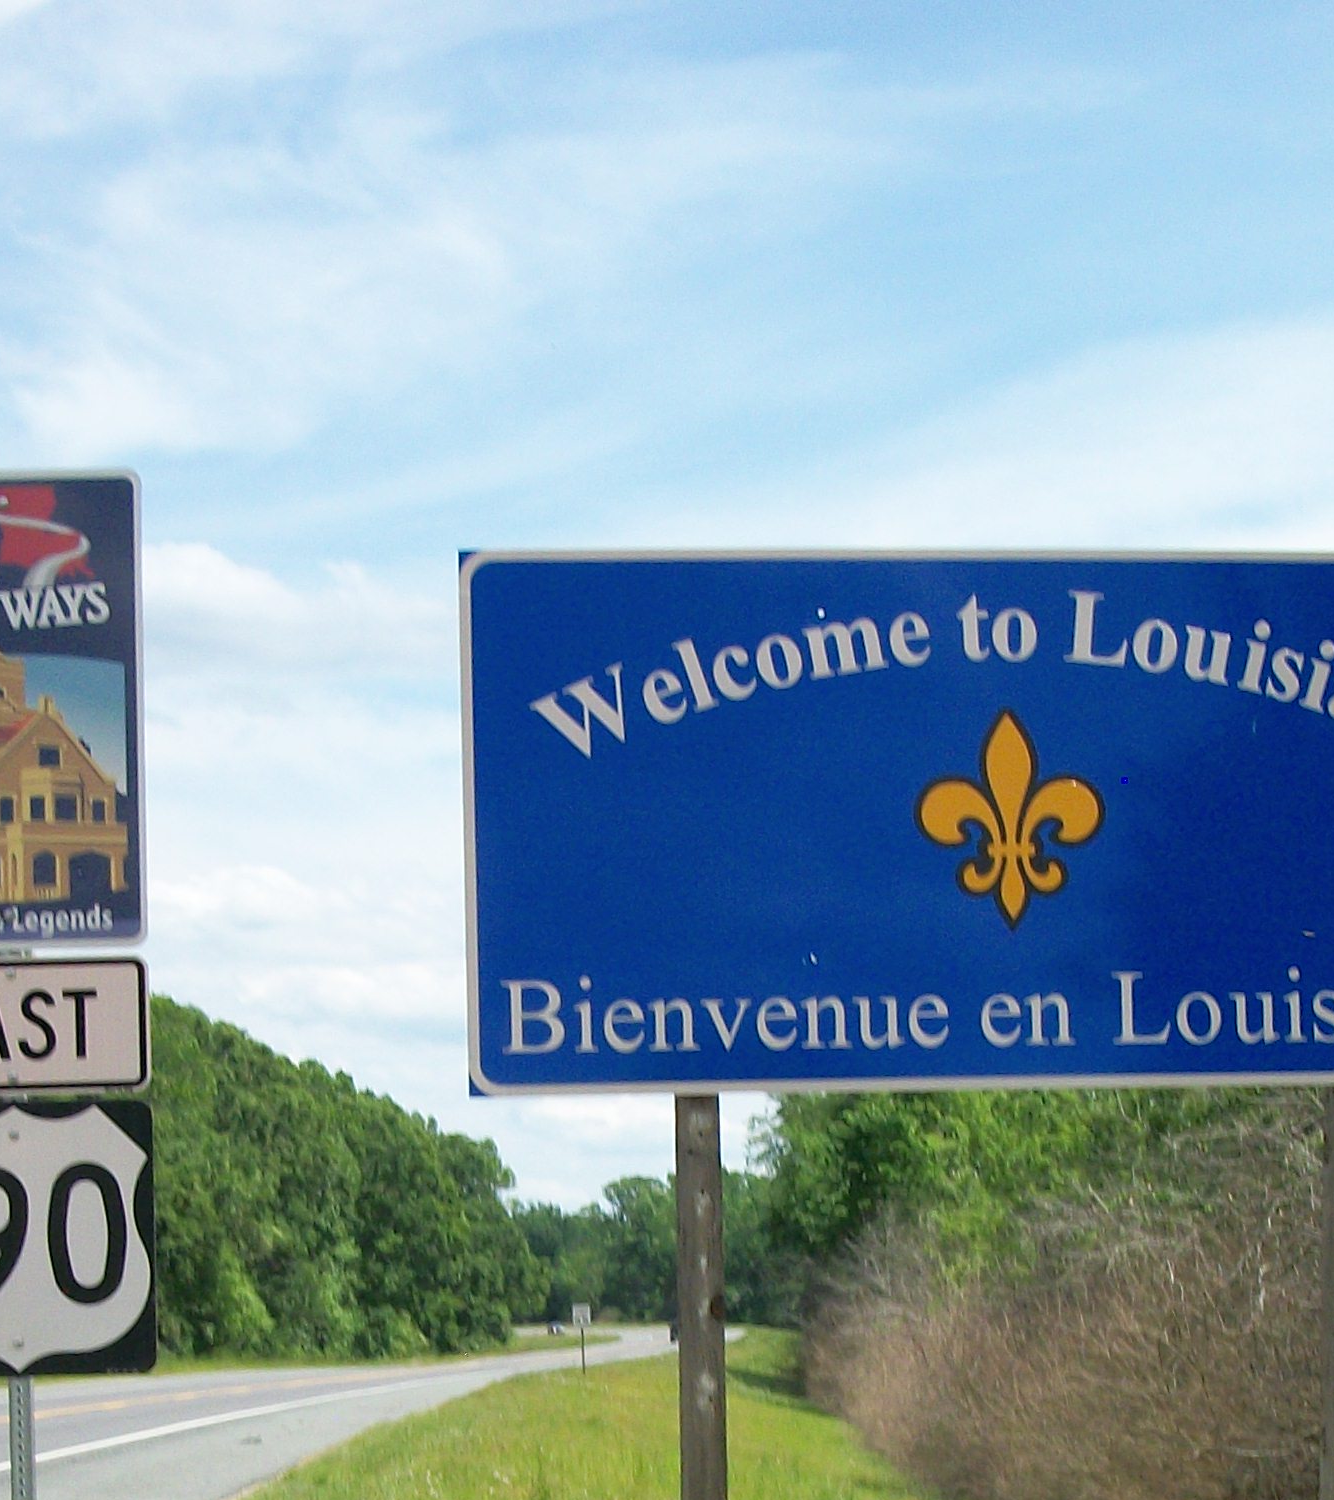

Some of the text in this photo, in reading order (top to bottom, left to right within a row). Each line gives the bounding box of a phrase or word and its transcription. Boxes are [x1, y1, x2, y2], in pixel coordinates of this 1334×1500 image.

[530, 612, 931, 760] Welcome
[957, 593, 1038, 662] to
[12, 902, 113, 938] Legends
[501, 976, 951, 1055] Bienvenue
[980, 993, 1072, 1047] en
